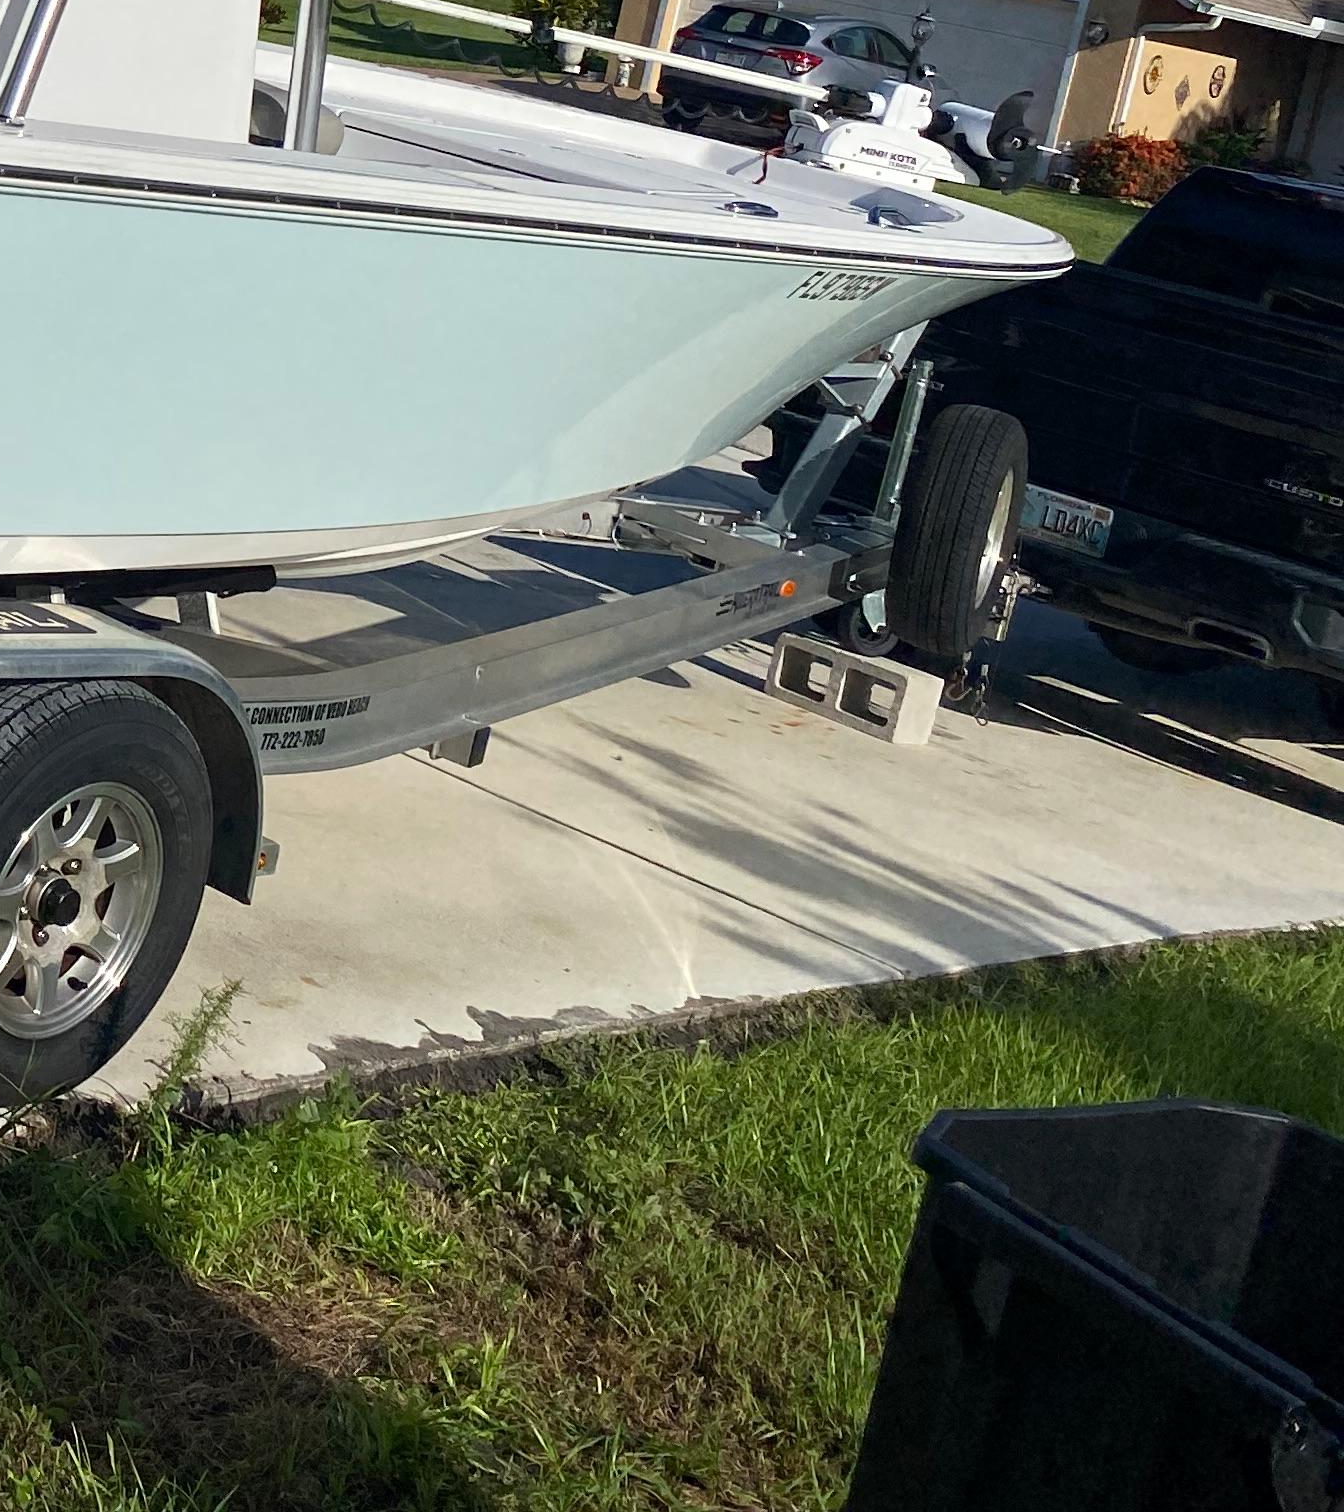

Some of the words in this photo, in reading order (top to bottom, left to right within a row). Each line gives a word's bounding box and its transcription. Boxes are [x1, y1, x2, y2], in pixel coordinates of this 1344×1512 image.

[890, 153, 917, 165] KOTA
[251, 704, 315, 725] CONNECTION
[314, 703, 328, 721] OF
